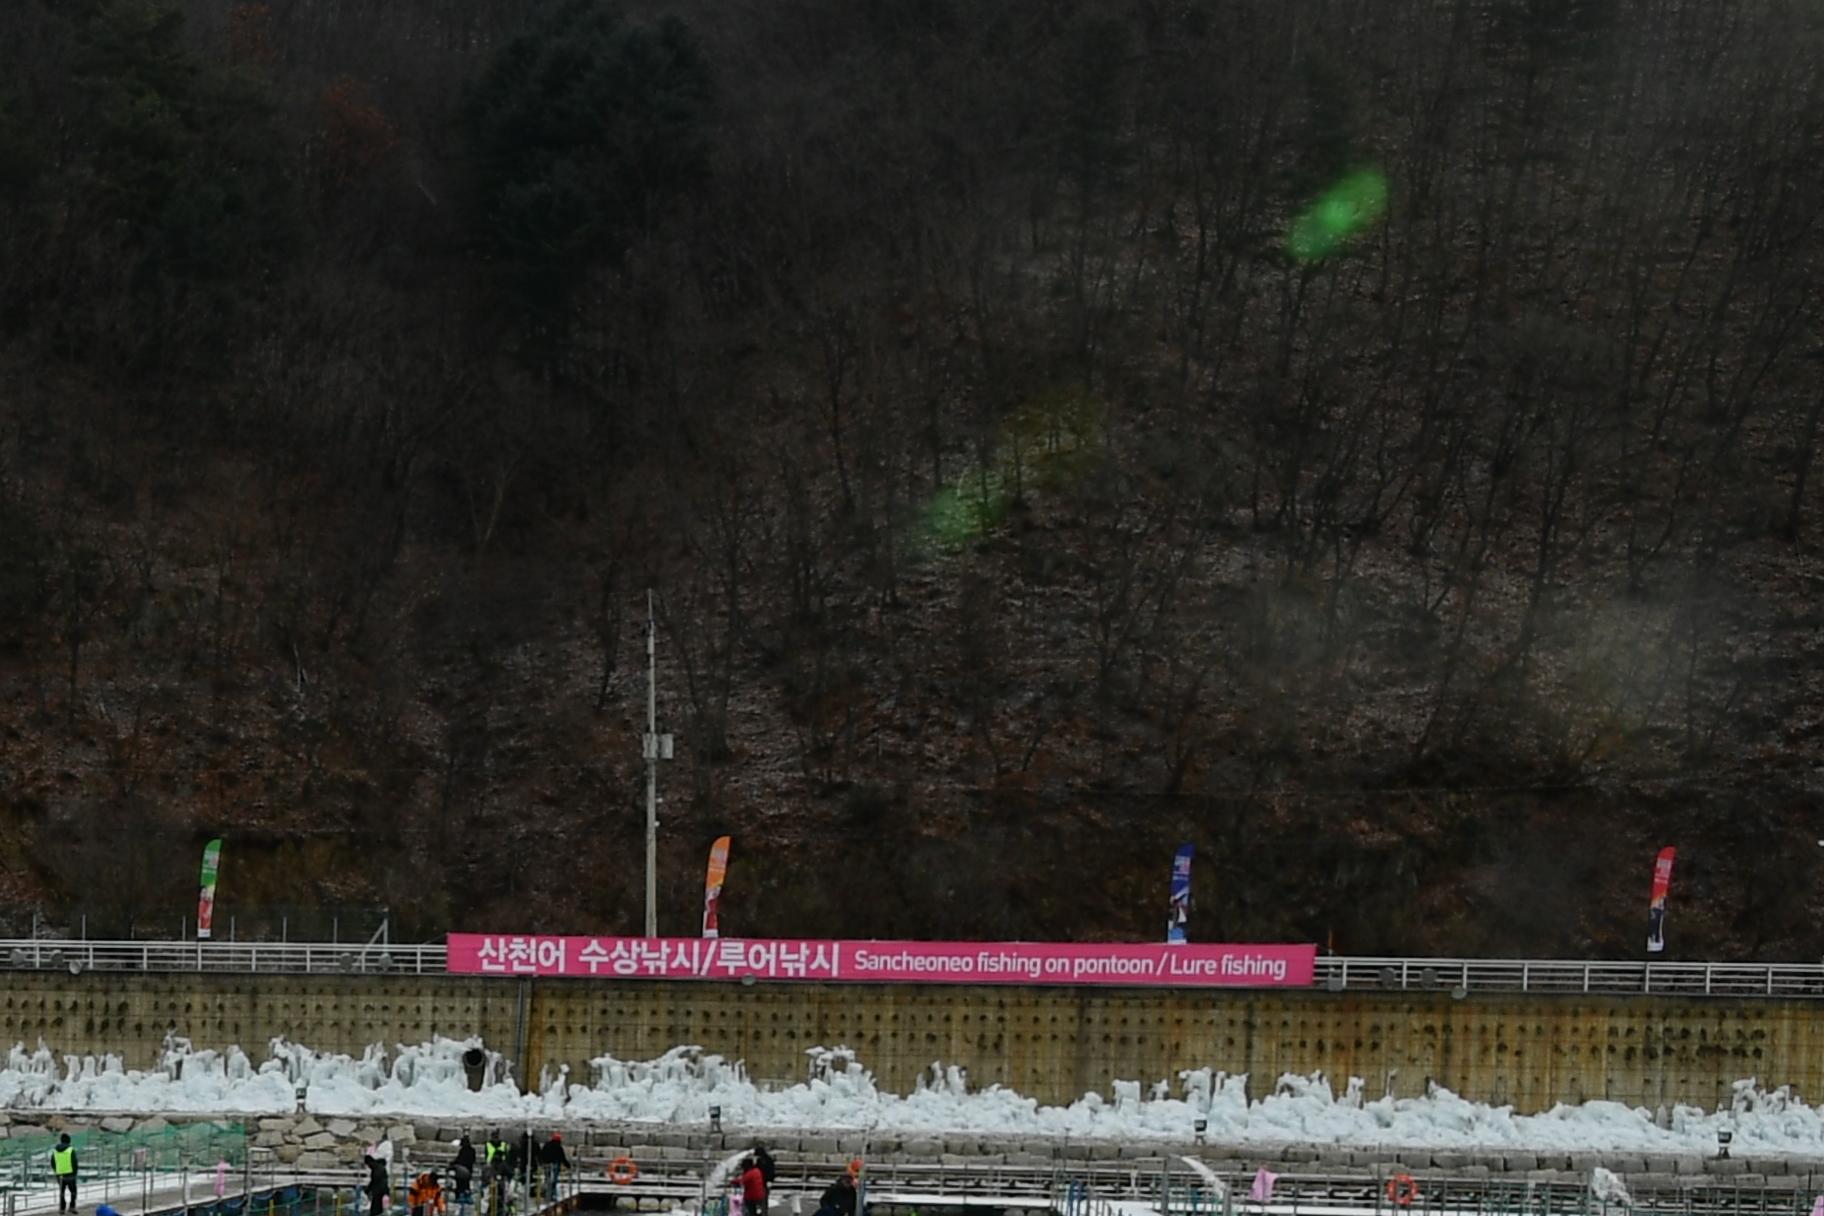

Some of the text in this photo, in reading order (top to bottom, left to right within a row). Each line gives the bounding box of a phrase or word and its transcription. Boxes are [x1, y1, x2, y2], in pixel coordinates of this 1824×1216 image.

[477, 938, 566, 973] 산천어
[854, 950, 973, 972] Sancheoneo
[977, 951, 1041, 978] fishing
[1045, 958, 1069, 974] on
[1074, 955, 1154, 980] pontoon
[1171, 953, 1217, 976] Lure
[1220, 953, 1286, 981] fishing
